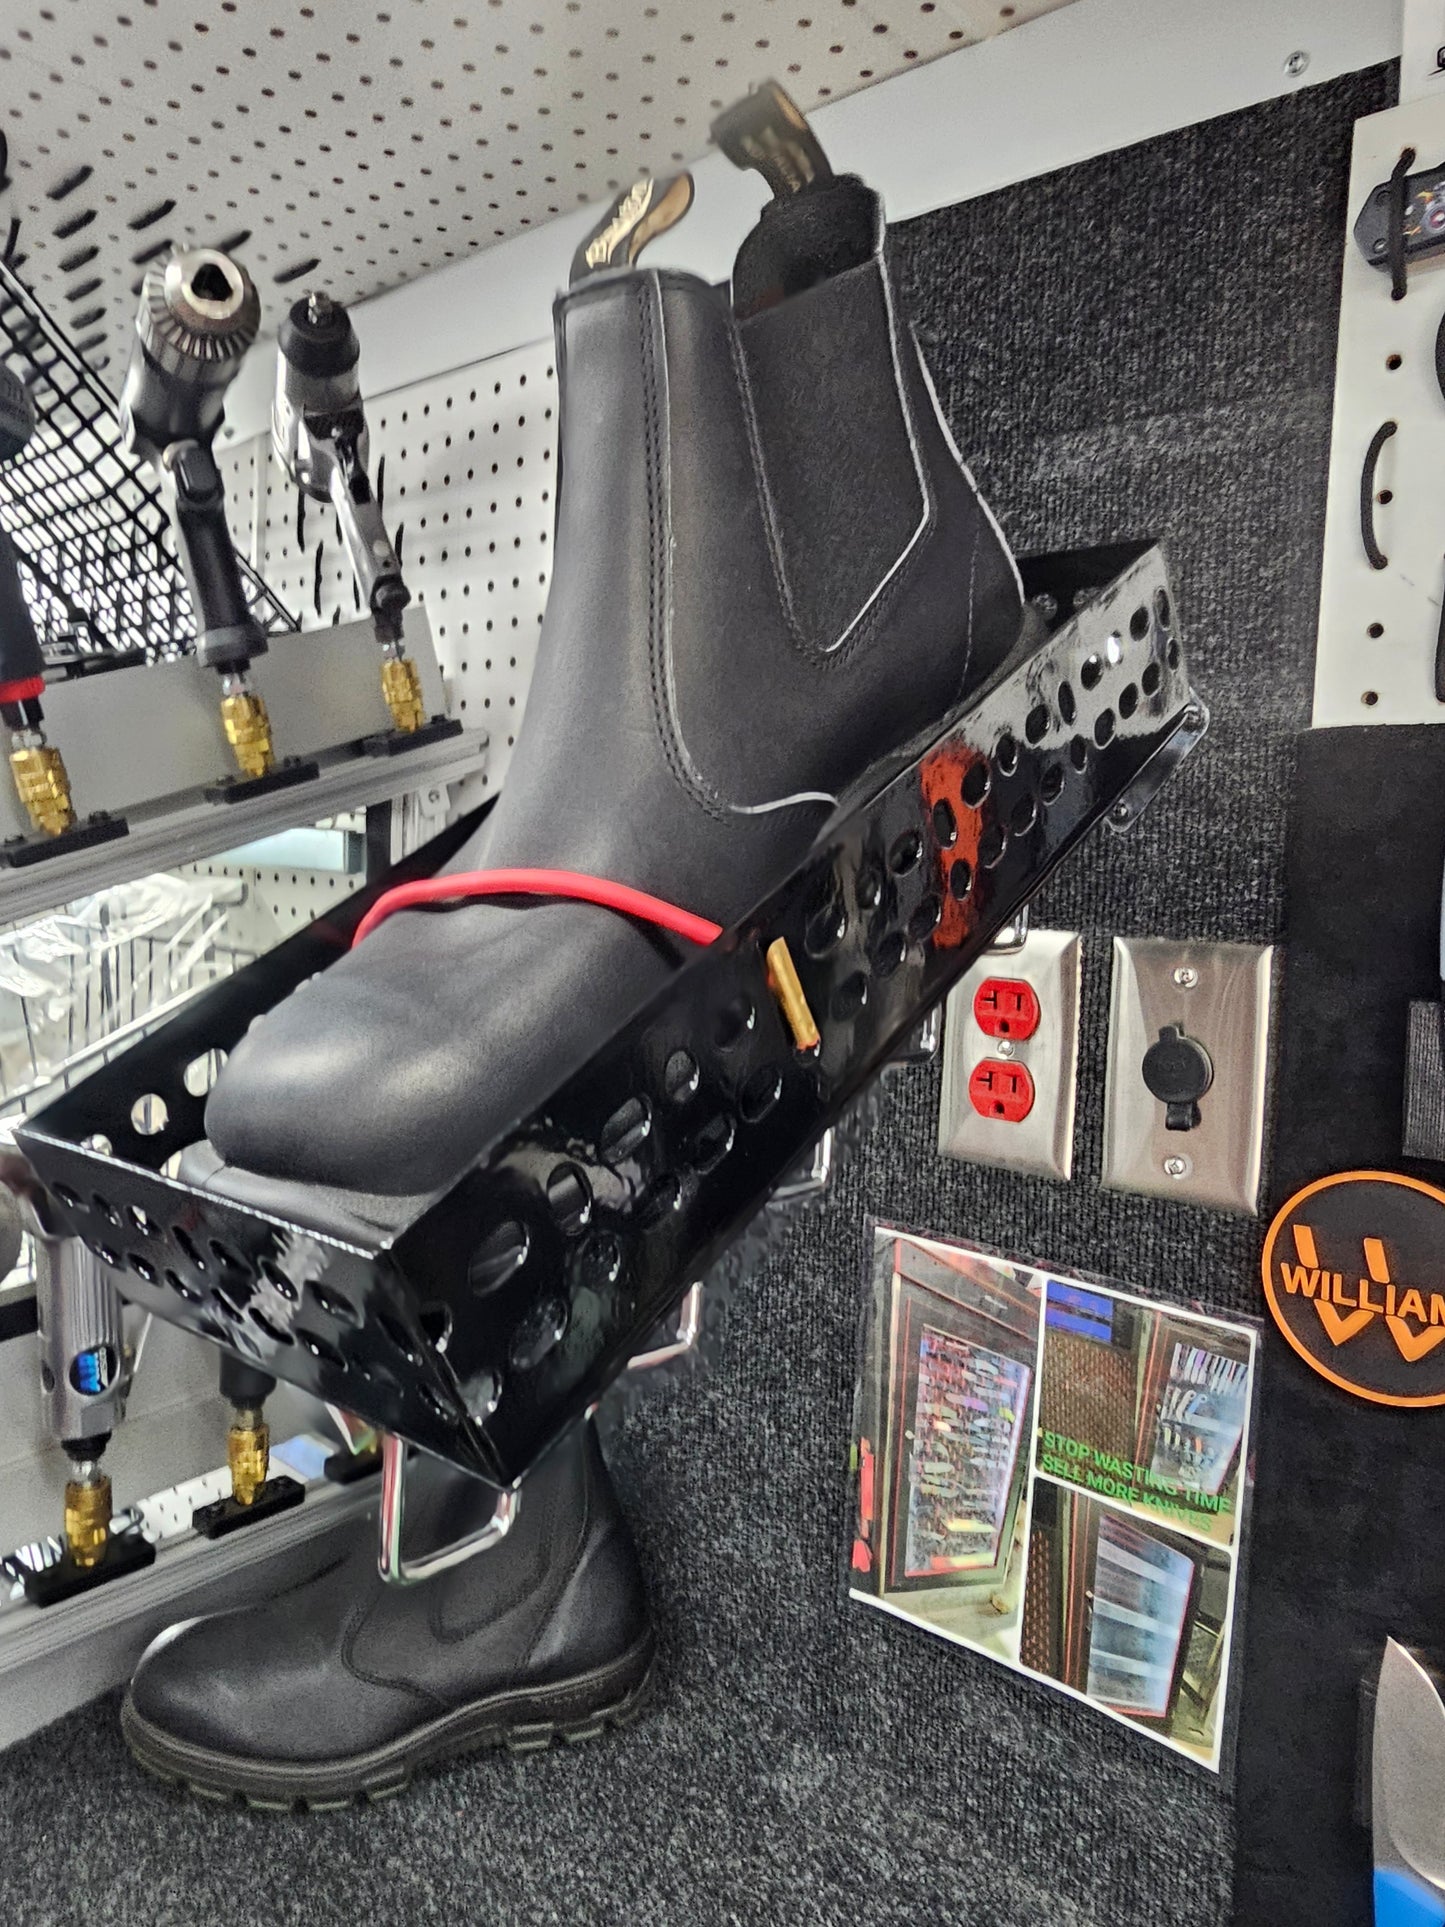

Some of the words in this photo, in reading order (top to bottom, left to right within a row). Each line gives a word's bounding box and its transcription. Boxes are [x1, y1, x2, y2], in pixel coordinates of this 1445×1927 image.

[1043, 1454, 1082, 1483] SELL
[1086, 1470, 1139, 1502] MORE
[1142, 1491, 1212, 1532] KNIVES
[1044, 1431, 1090, 1458] STOP
[1094, 1450, 1178, 1497] WASTING
[1184, 1489, 1231, 1513] TIME
